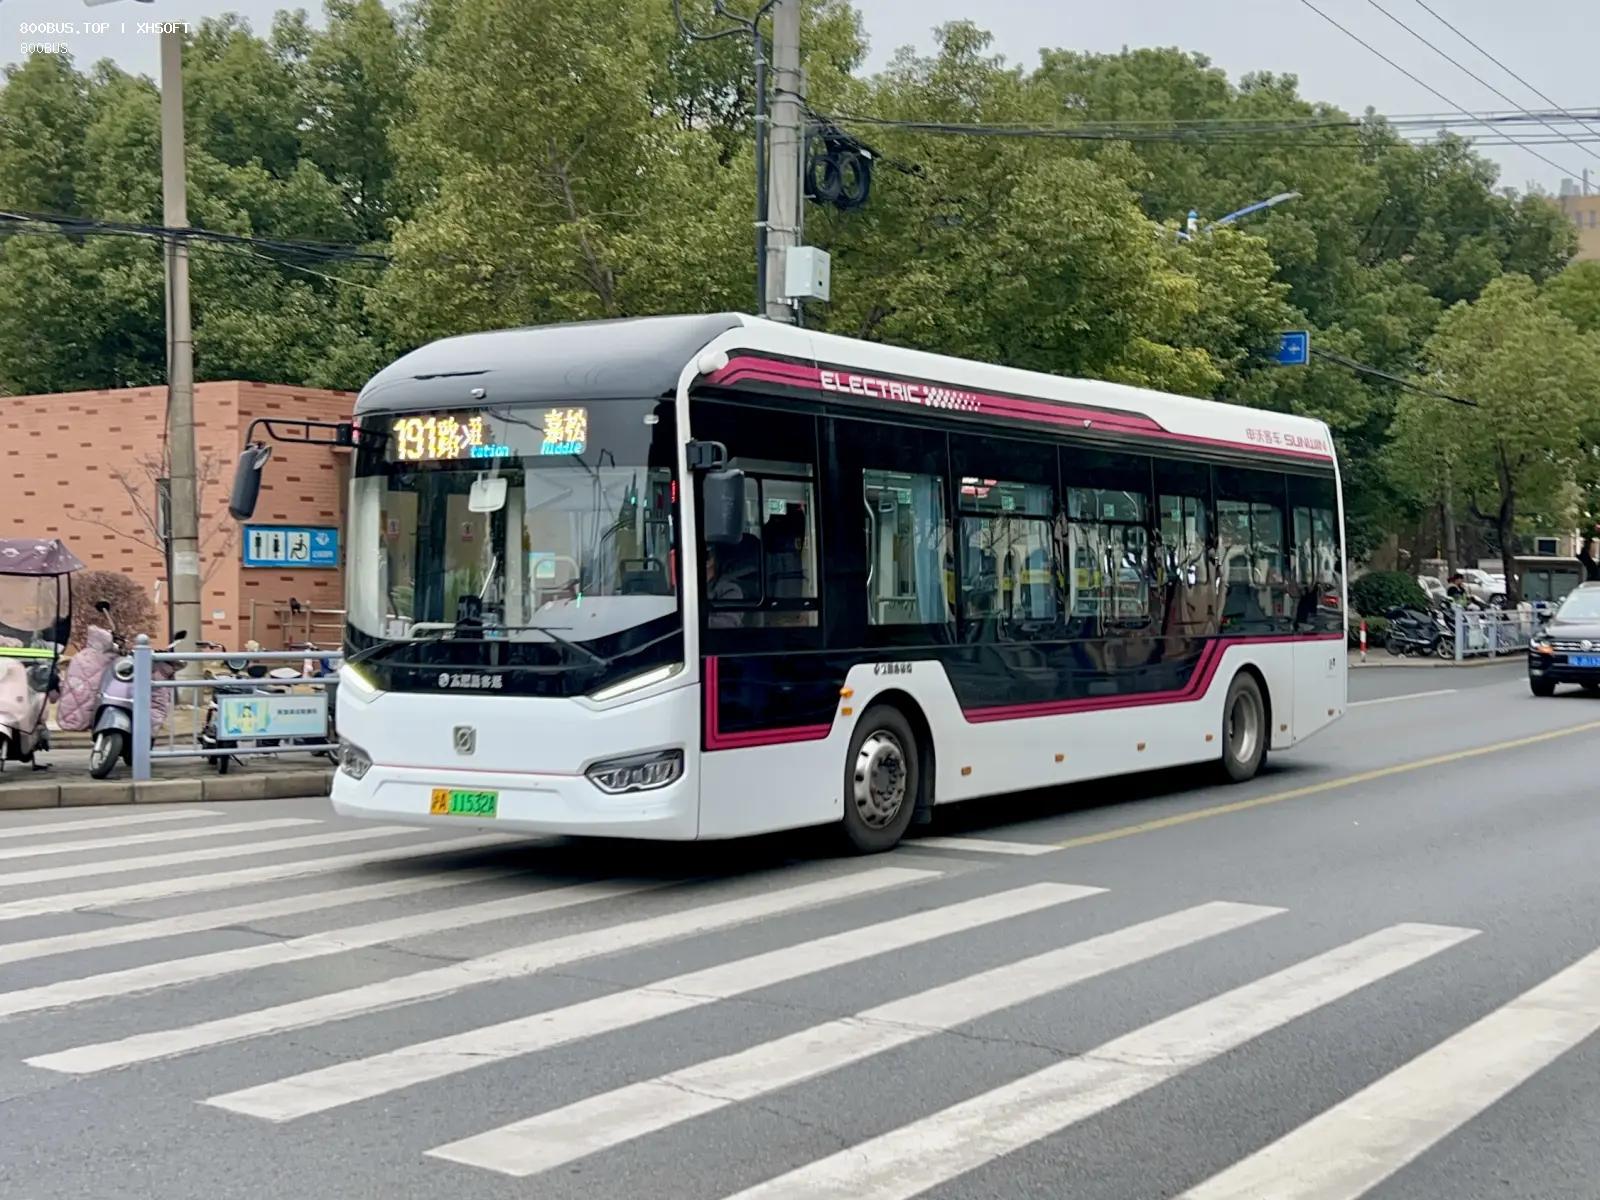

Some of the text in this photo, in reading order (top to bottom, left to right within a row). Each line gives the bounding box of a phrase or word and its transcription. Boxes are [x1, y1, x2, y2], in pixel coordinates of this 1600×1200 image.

[820, 371, 921, 403] ELECTRIC
[393, 416, 463, 460] 191路
[1246, 428, 1327, 451] 申沃客车 SUNWIN
